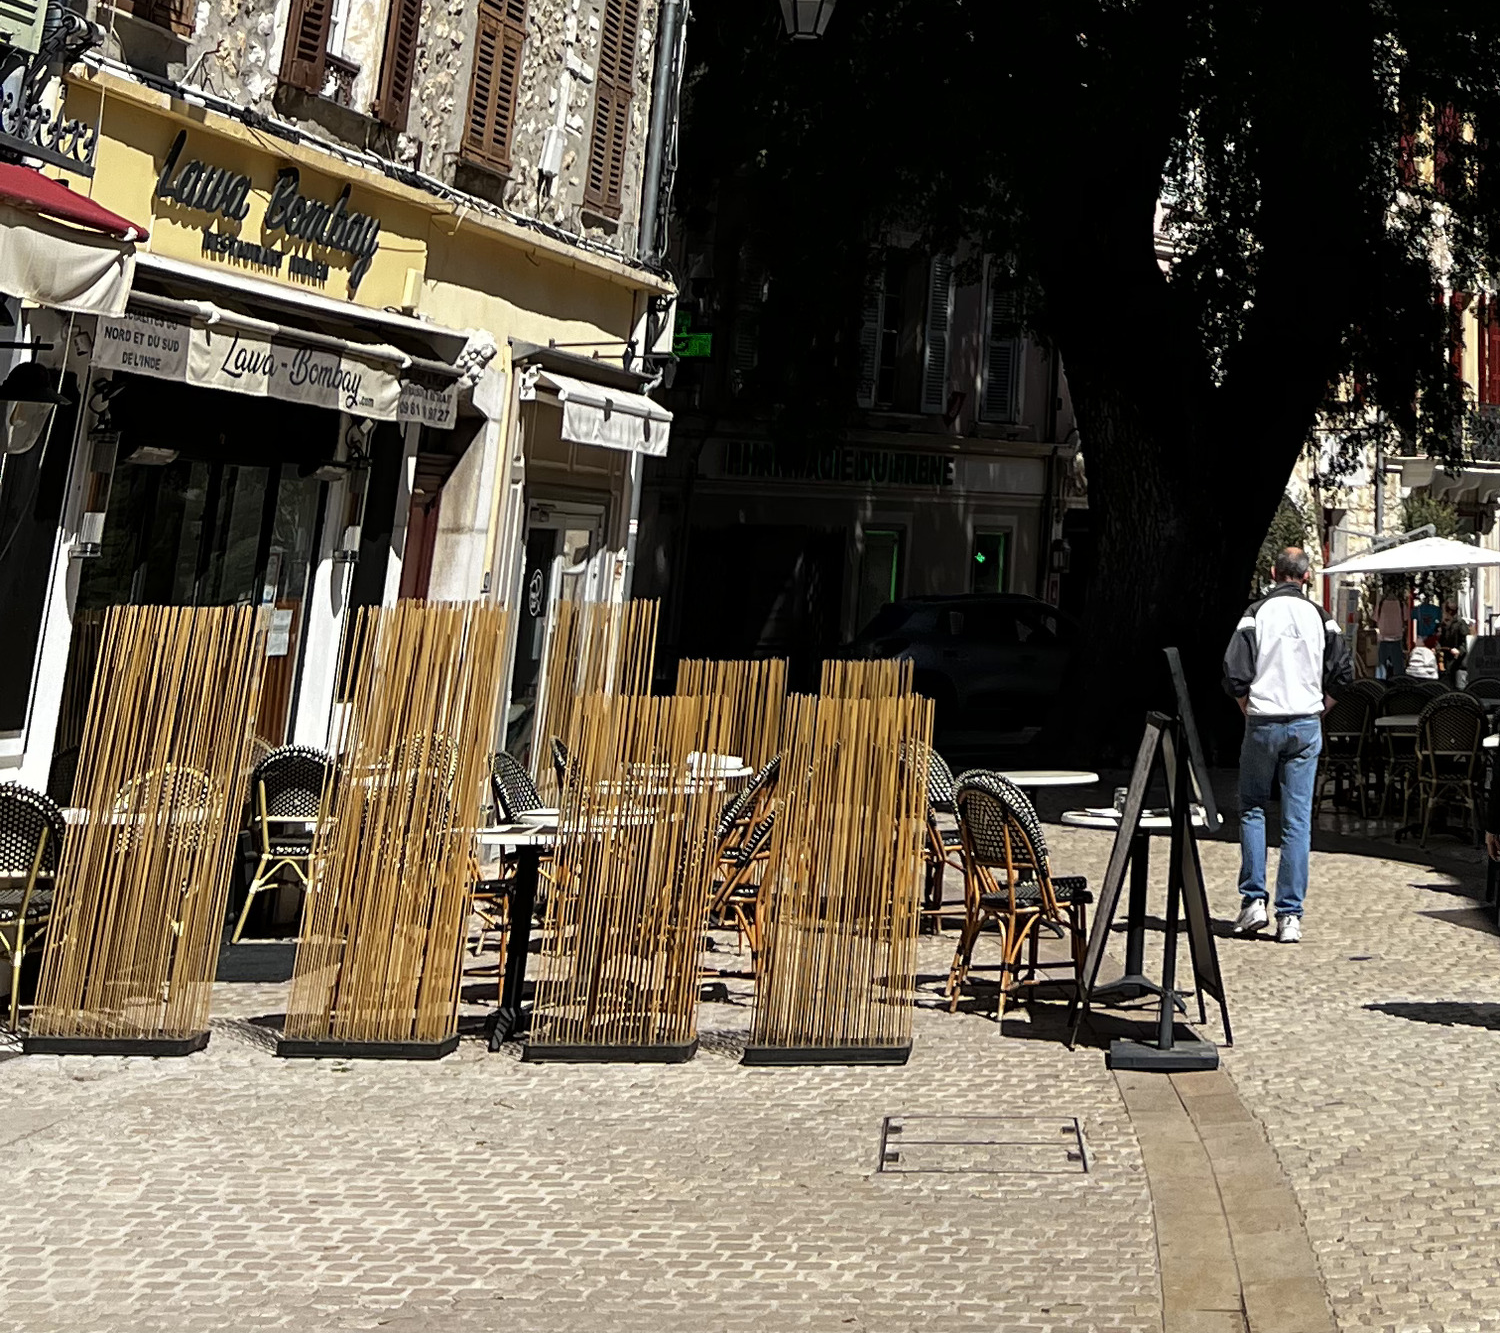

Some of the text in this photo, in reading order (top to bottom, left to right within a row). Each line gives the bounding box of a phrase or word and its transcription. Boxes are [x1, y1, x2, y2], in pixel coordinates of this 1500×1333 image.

[157, 129, 380, 301] Lawa Bombay
[104, 326, 180, 353] NORD ET DU SUD
[122, 351, 134, 365] DE
